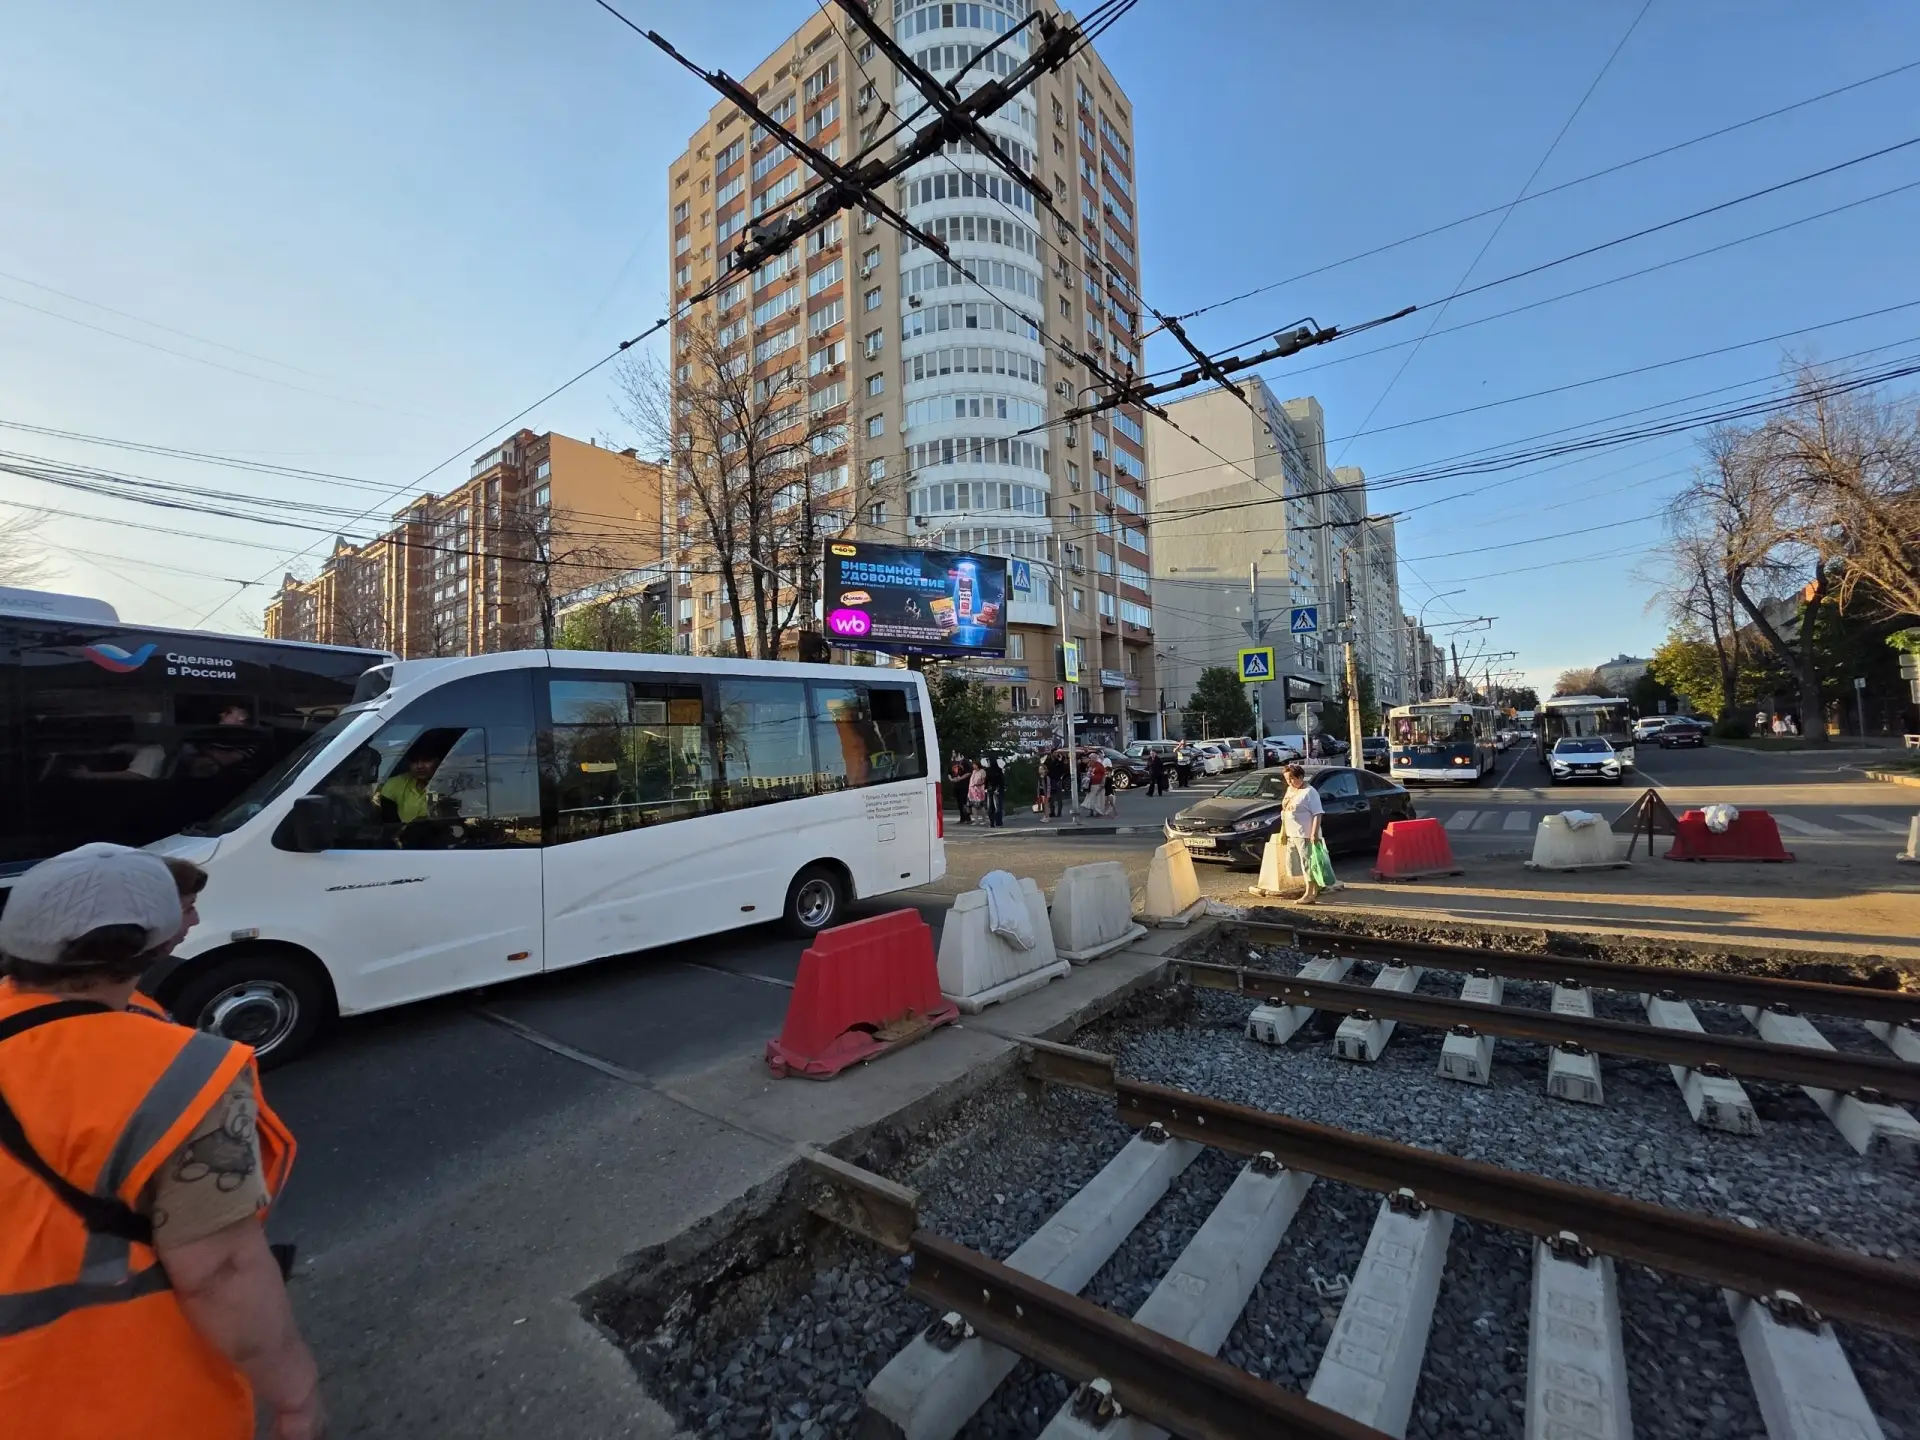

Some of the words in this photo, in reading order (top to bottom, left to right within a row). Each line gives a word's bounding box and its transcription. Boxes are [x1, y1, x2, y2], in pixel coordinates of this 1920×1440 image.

[841, 560, 922, 577] ВНЕЗЕМНОЕ
[841, 571, 945, 588] УДОВОЛЬСТВИЕ
[166, 652, 233, 667] Сделано
[167, 666, 177, 675] в
[181, 666, 236, 679] России
[1018, 729, 1037, 737] Loud
